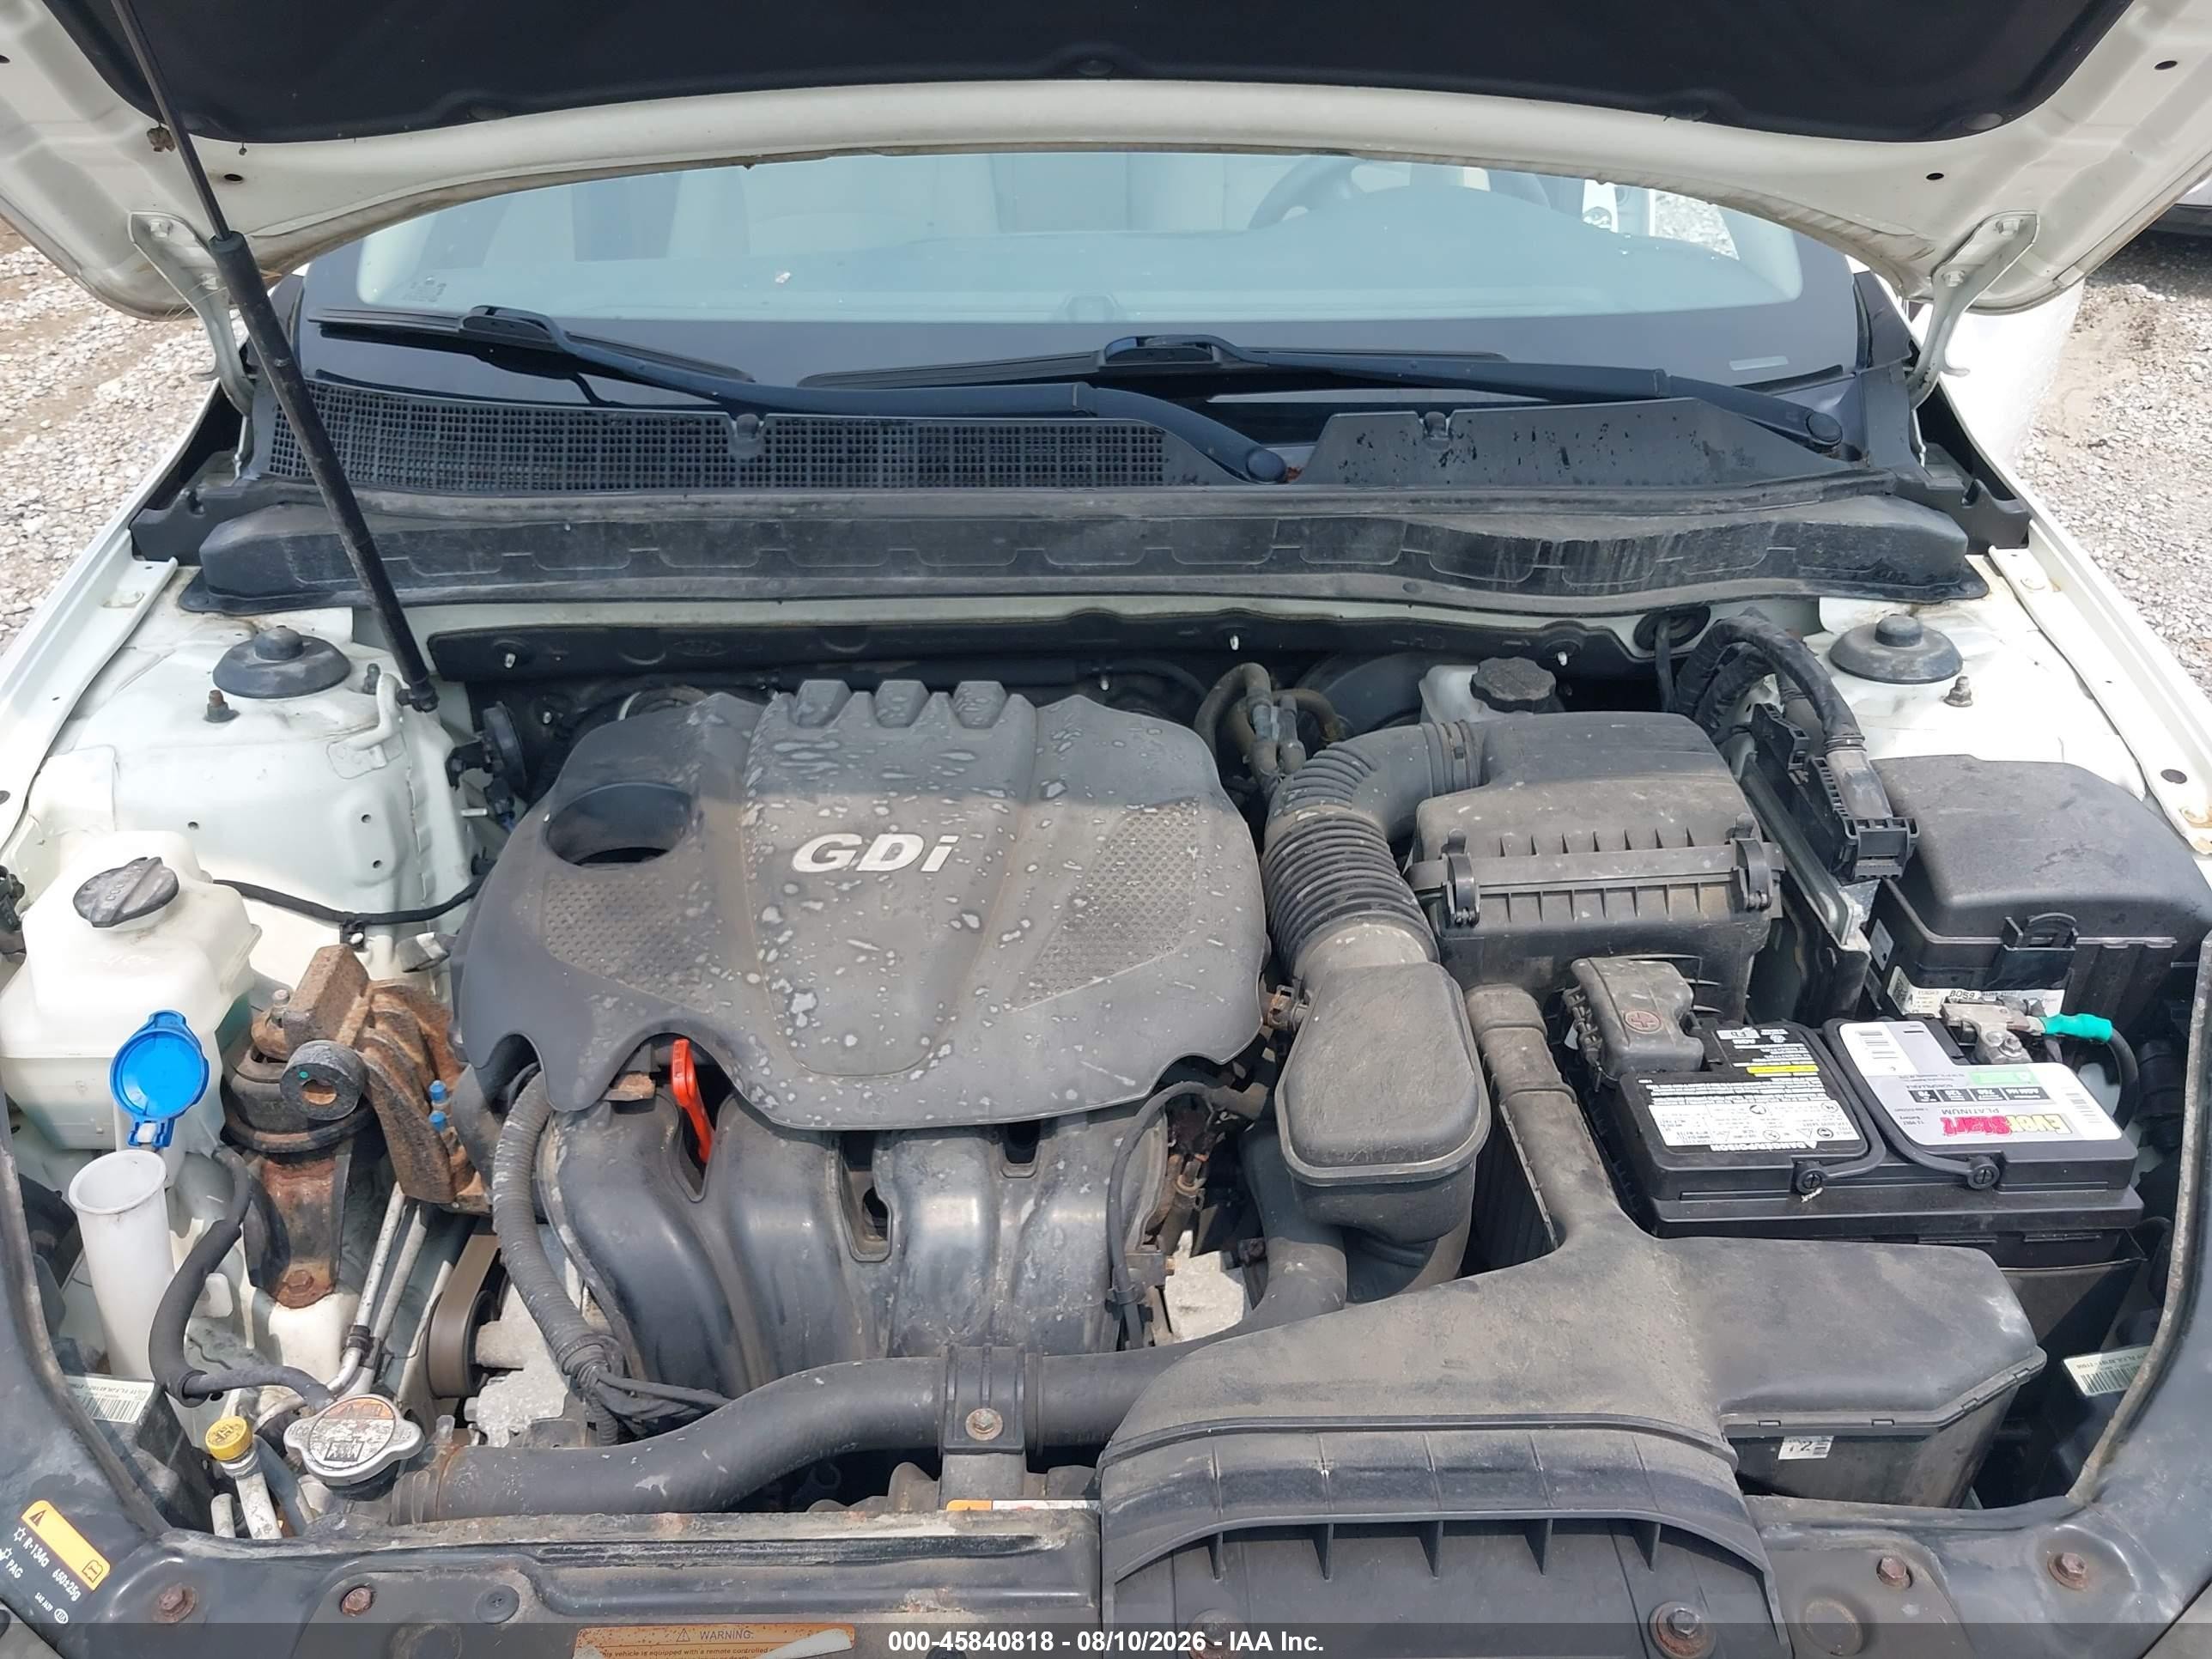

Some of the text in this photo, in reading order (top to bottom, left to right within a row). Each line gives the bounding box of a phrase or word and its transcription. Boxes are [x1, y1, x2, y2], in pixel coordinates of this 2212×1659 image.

[791, 833, 960, 873] GDi
[22, 1536, 50, 1568] R-134a
[5, 1559, 24, 1578] PAG
[52, 1568, 82, 1601] 650±25g
[649, 1649, 682, 1657] equipped
